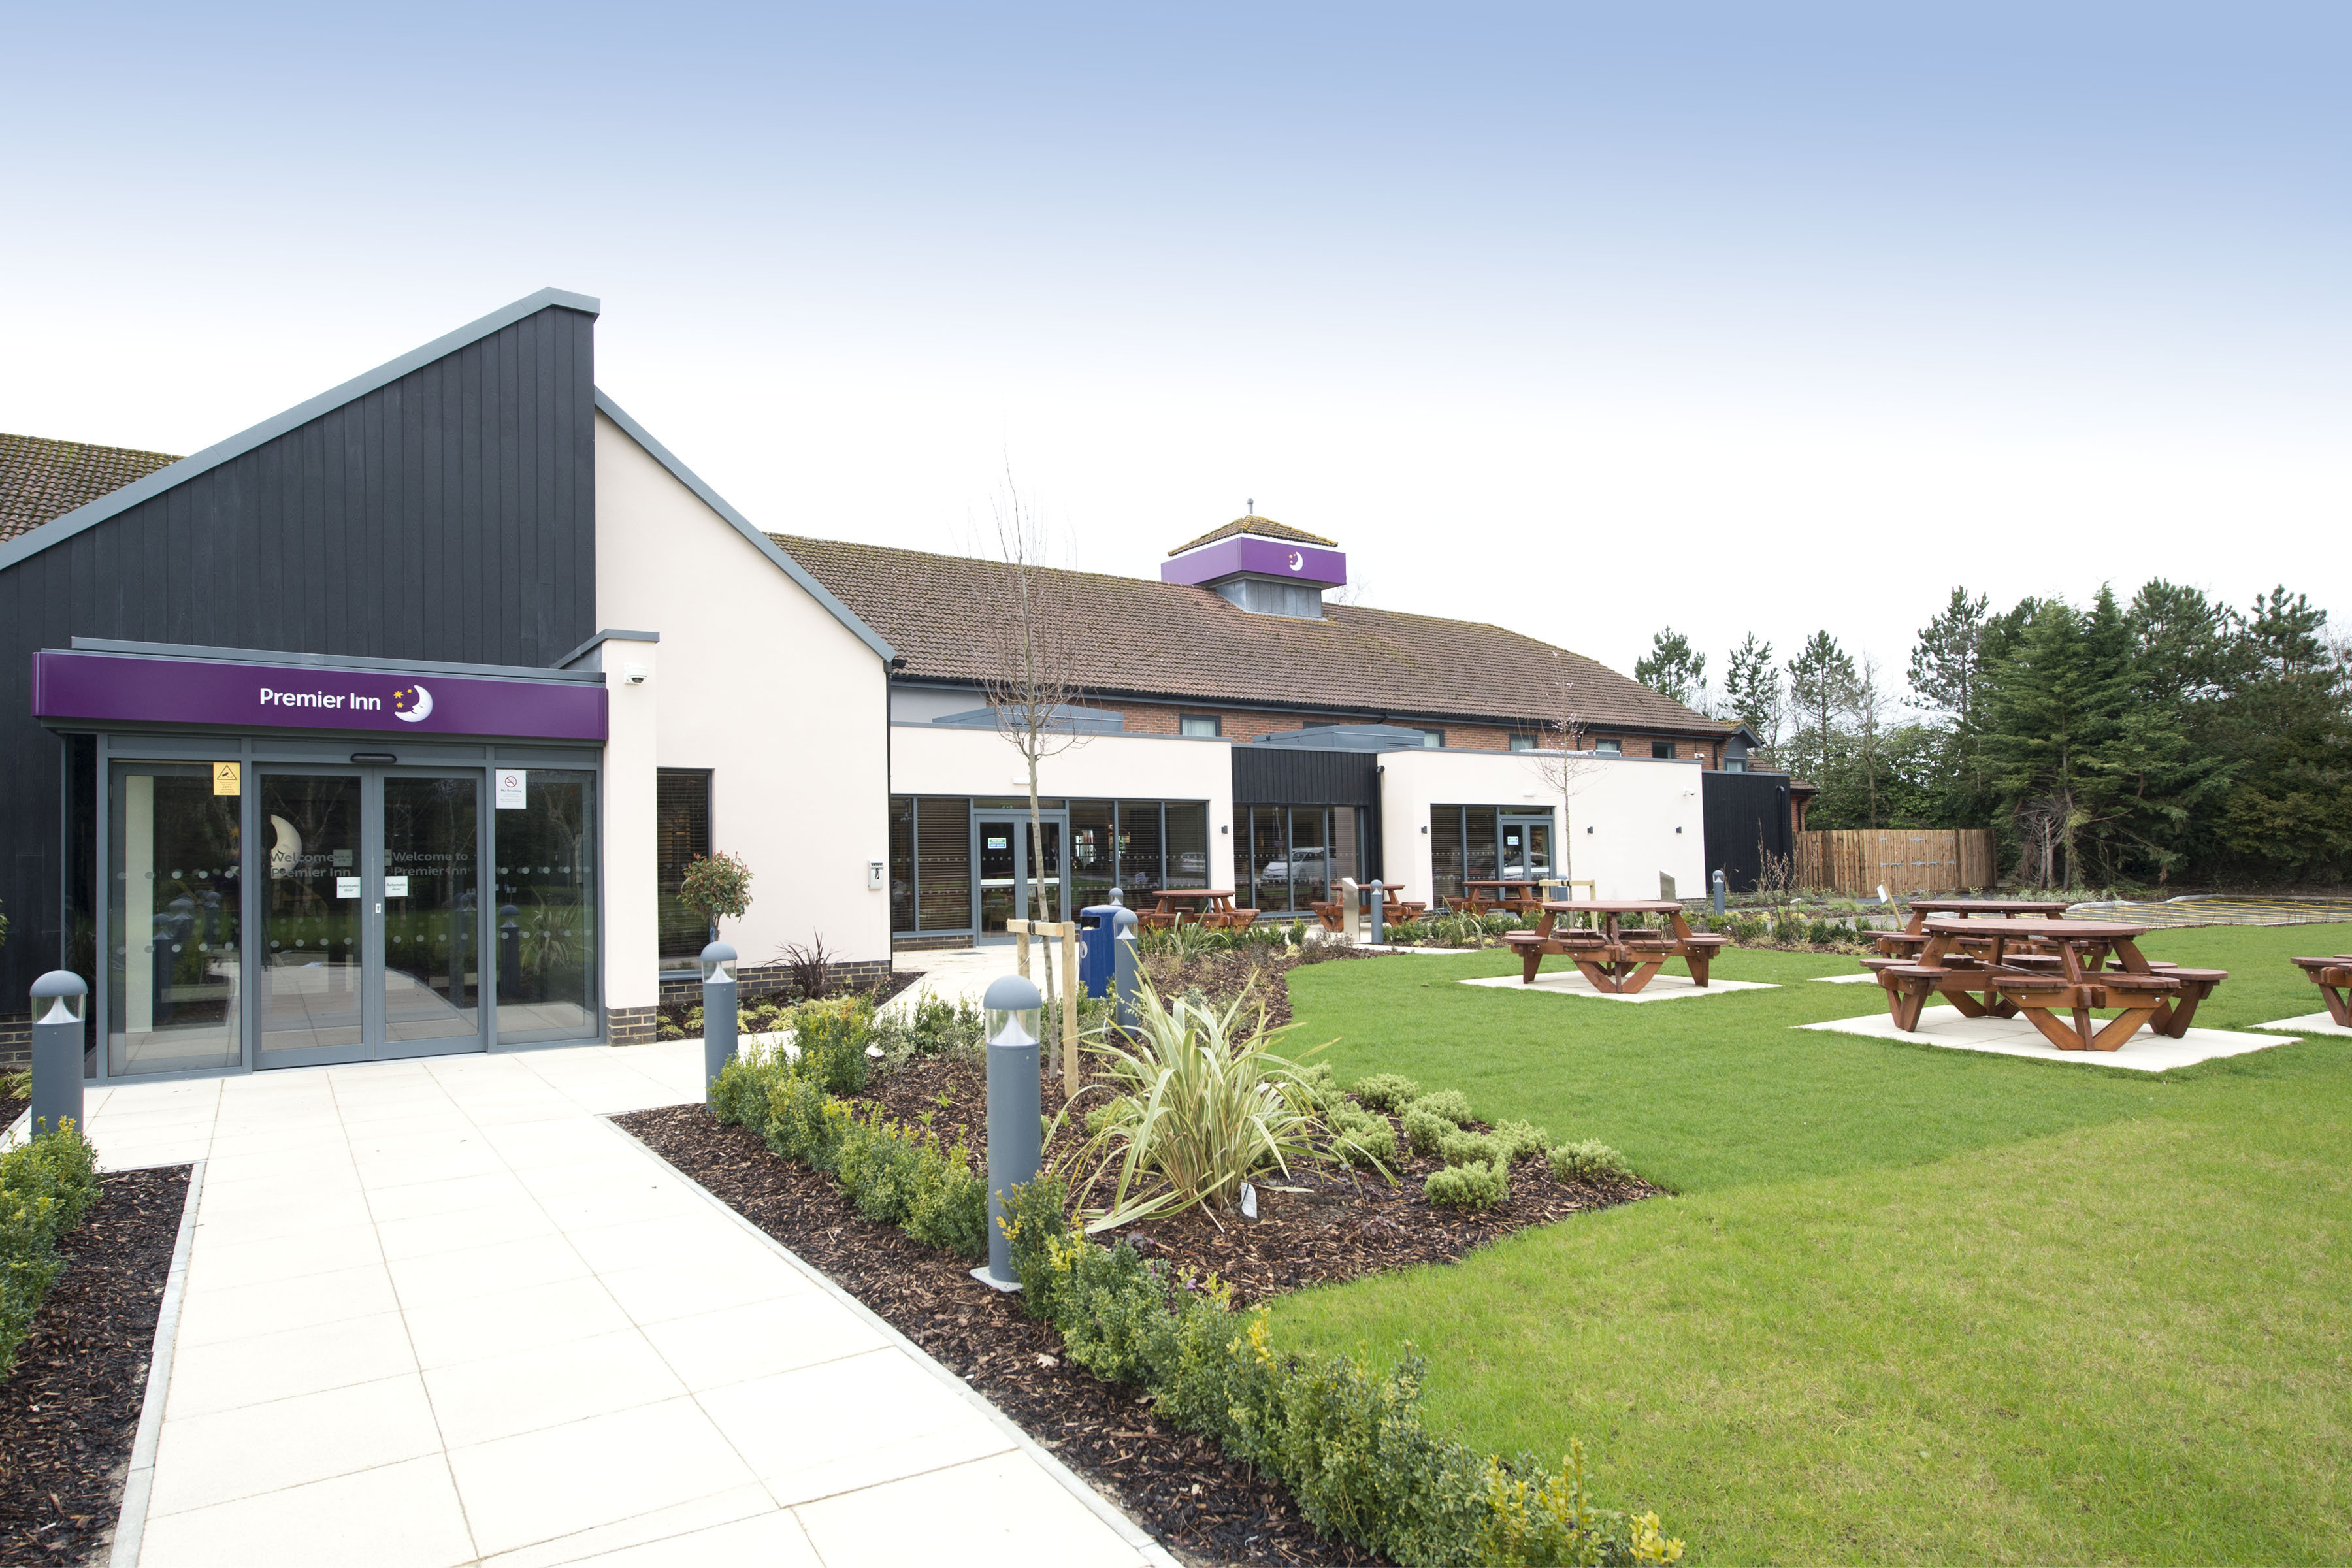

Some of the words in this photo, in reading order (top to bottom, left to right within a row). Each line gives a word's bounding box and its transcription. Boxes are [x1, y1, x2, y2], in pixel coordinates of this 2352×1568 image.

[260, 688, 345, 708] Premier
[350, 693, 380, 710] Inn
[271, 852, 334, 862] Welcome
[393, 851, 452, 862] Welcome
[455, 853, 468, 861] to
[329, 867, 351, 877] Inn
[394, 866, 444, 876] Premier
[446, 866, 467, 875] Inn
